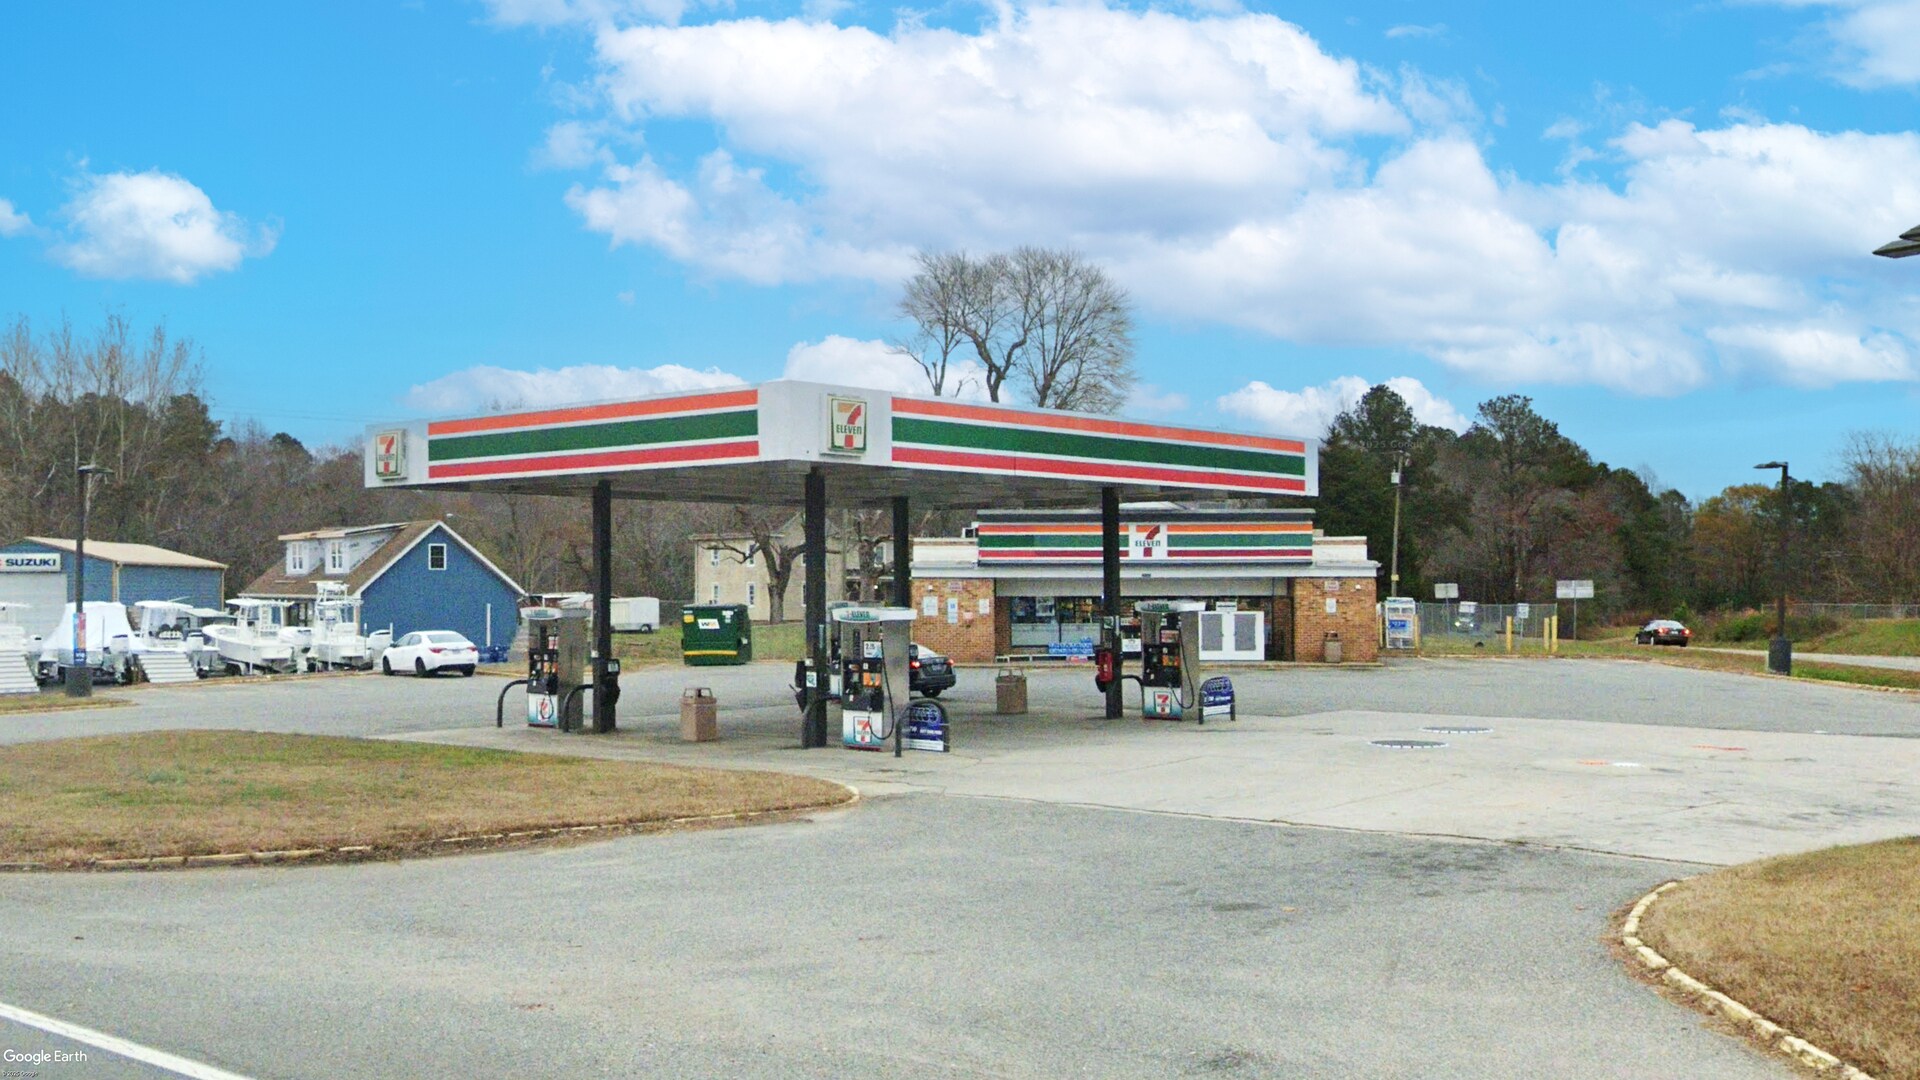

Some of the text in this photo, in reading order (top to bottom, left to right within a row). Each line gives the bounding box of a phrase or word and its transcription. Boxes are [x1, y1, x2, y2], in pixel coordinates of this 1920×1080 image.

[838, 402, 862, 448] 7
[379, 435, 395, 474] 7
[1136, 524, 1160, 557] 7
[5, 558, 57, 567] SUZUKI
